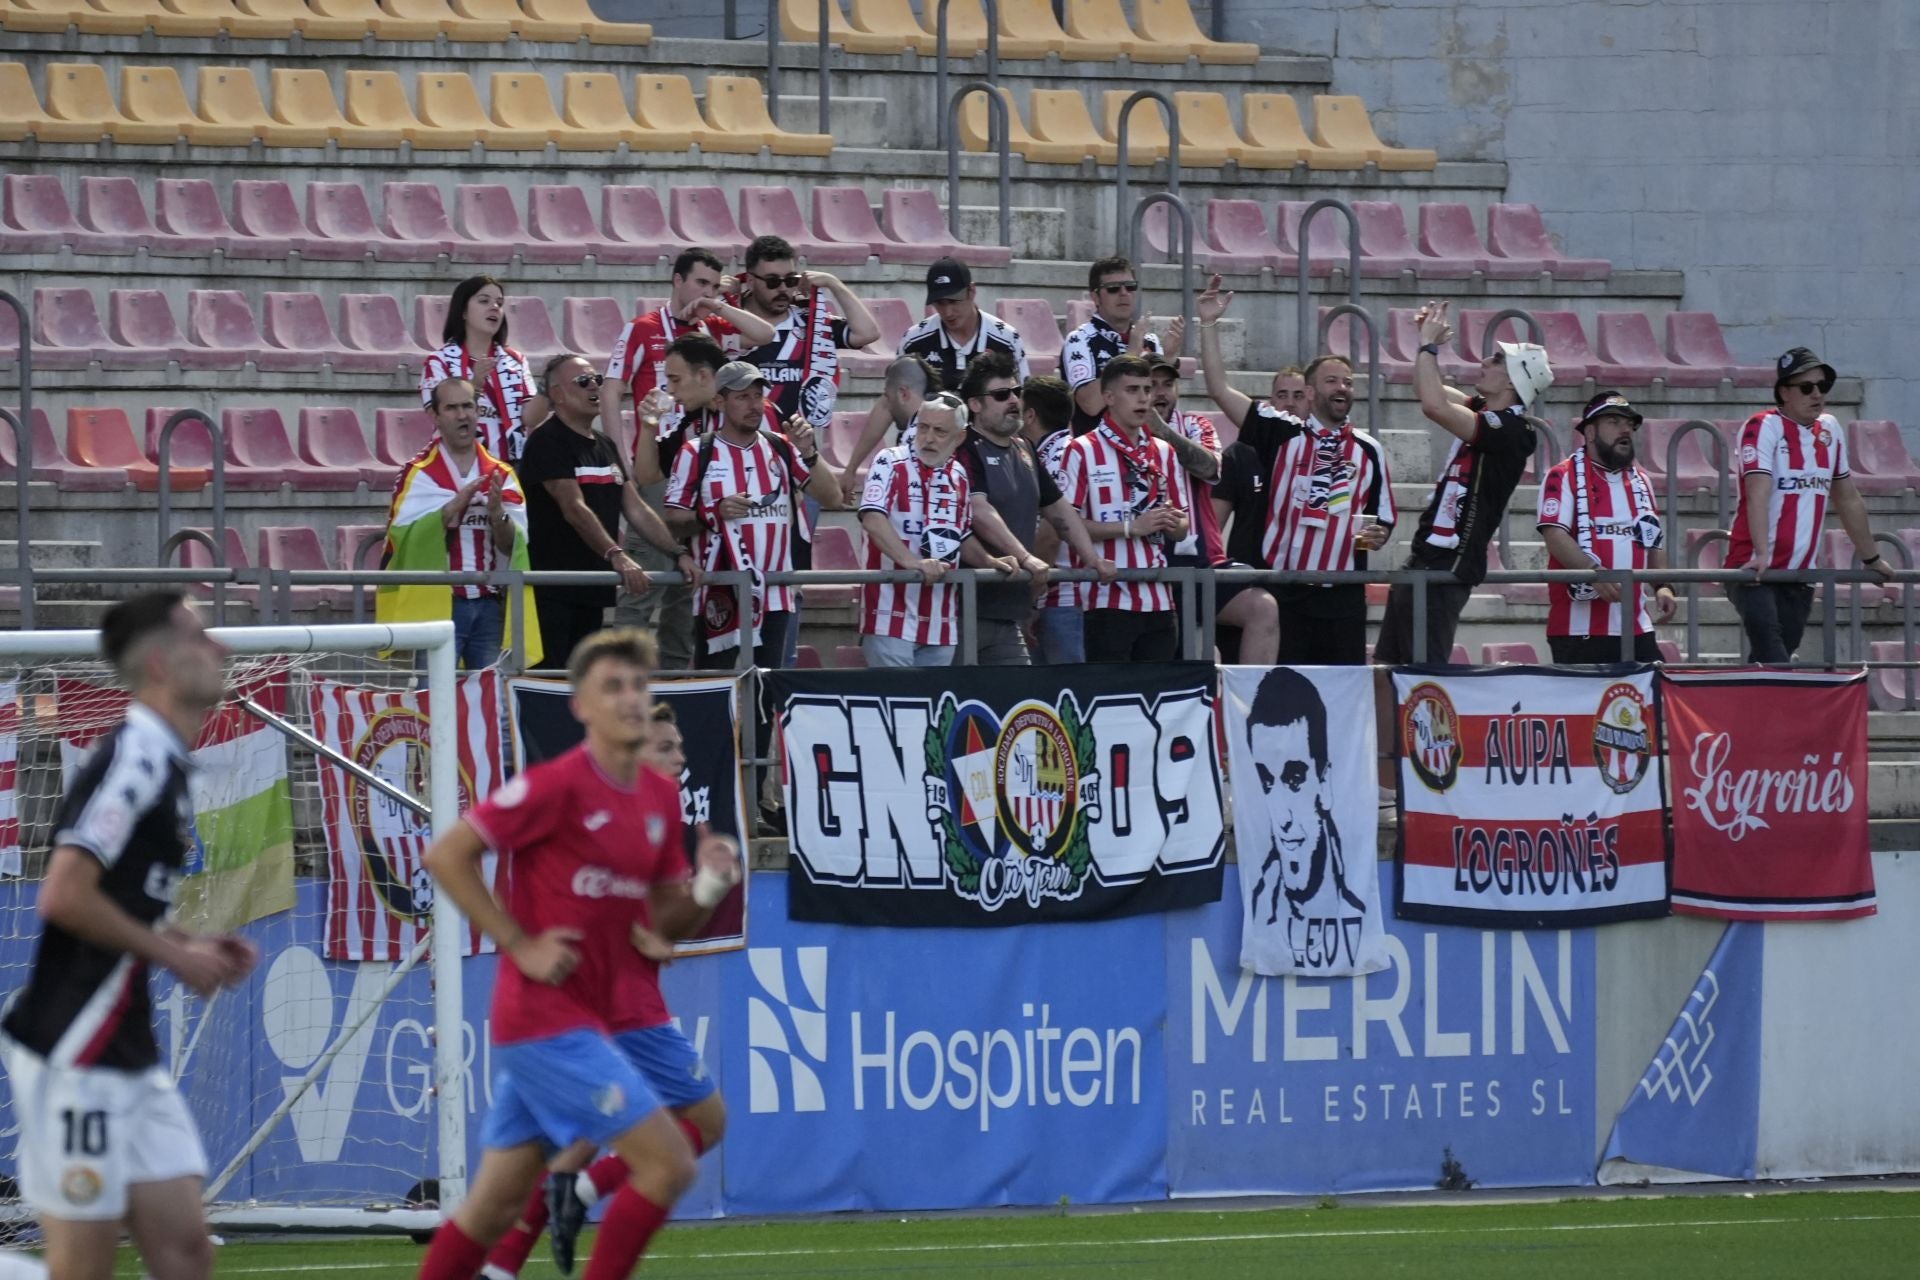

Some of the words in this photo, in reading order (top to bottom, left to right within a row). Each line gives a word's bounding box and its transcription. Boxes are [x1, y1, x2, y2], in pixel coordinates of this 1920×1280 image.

[782, 694, 946, 888] GN
[1086, 687, 1226, 886] 09
[1485, 701, 1572, 785] AÚPA
[1684, 732, 1854, 841] Logroñés
[1024, 855, 1073, 904] Tour
[1453, 811, 1620, 896] LOGROÑÉS
[1191, 930, 1572, 1064] MERLIN
[851, 1003, 1142, 1132] Hospiten
[1191, 1088, 1293, 1126] REAL
[1324, 1080, 1501, 1122] ESTATES
[1531, 1079, 1572, 1115] SL
[61, 1109, 108, 1156] 10
